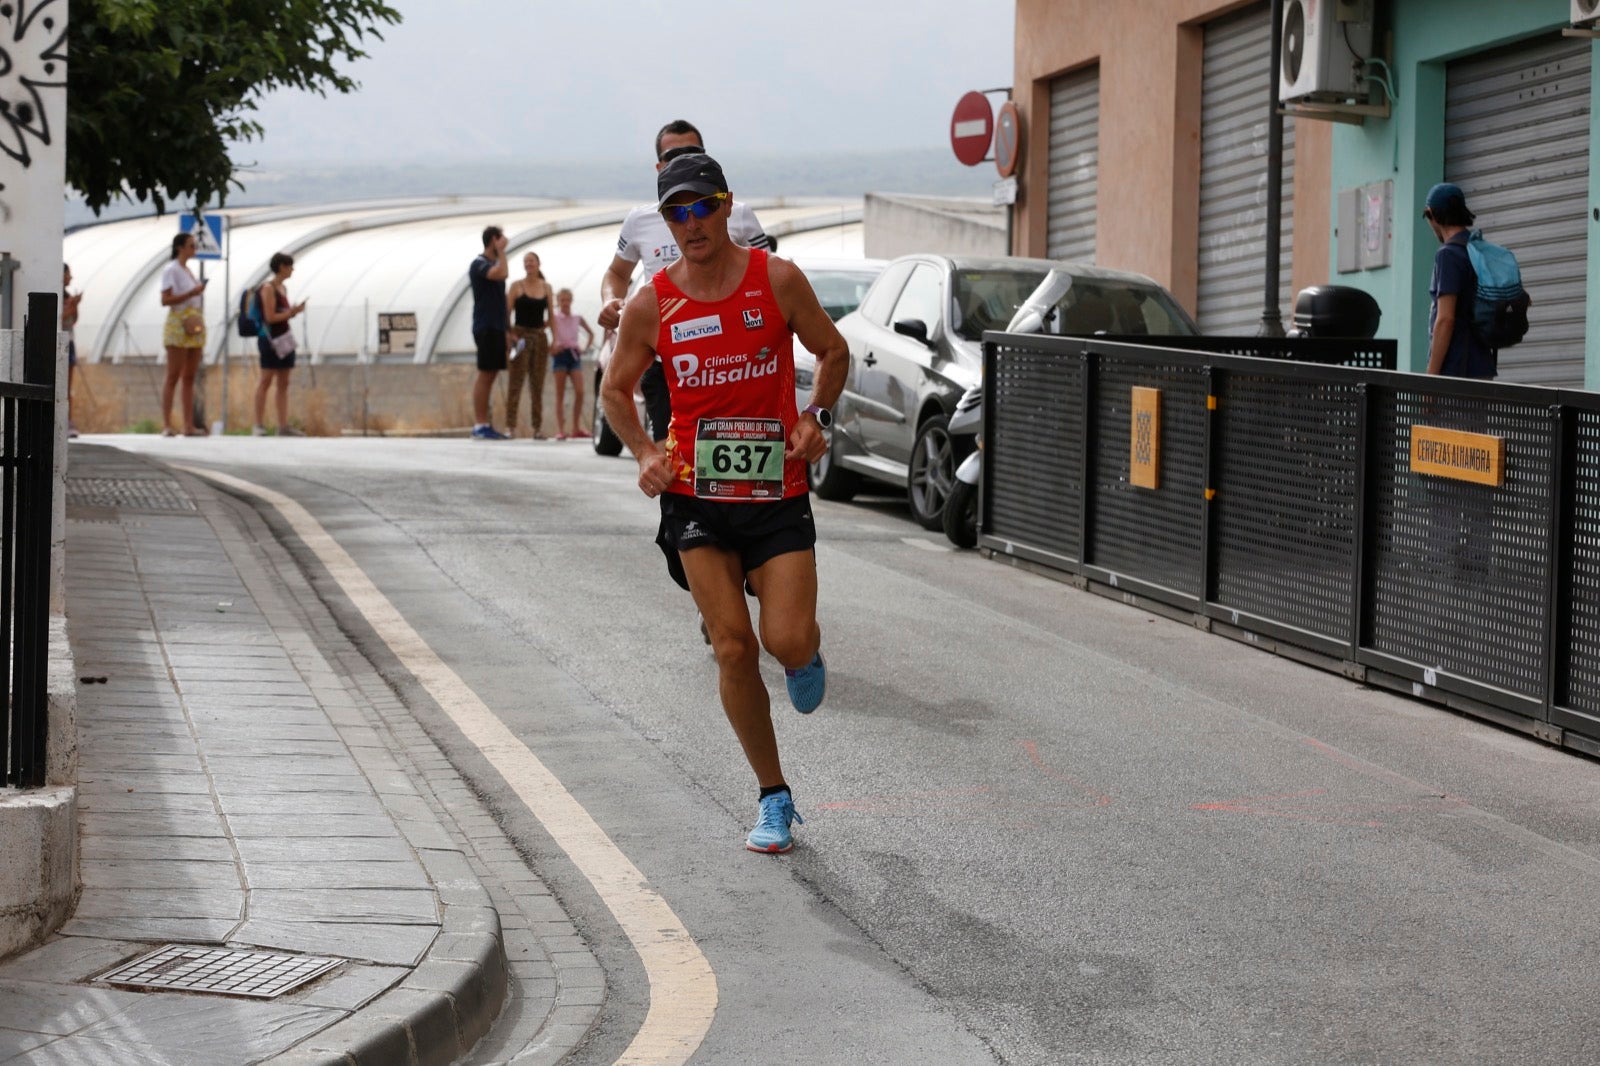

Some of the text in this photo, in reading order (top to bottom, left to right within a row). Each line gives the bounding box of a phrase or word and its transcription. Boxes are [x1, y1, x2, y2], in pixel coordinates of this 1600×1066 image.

[744, 312, 750, 321] I
[672, 354, 778, 388] Polisalud
[704, 353, 748, 368] Clínicas
[717, 421, 733, 431] GRAN
[734, 422, 755, 432] PREMIO
[755, 422, 763, 432] DE
[764, 422, 780, 432] FONDO
[712, 444, 772, 474] 637
[1418, 438, 1491, 473] CERVEZAS ALHAMBRA
